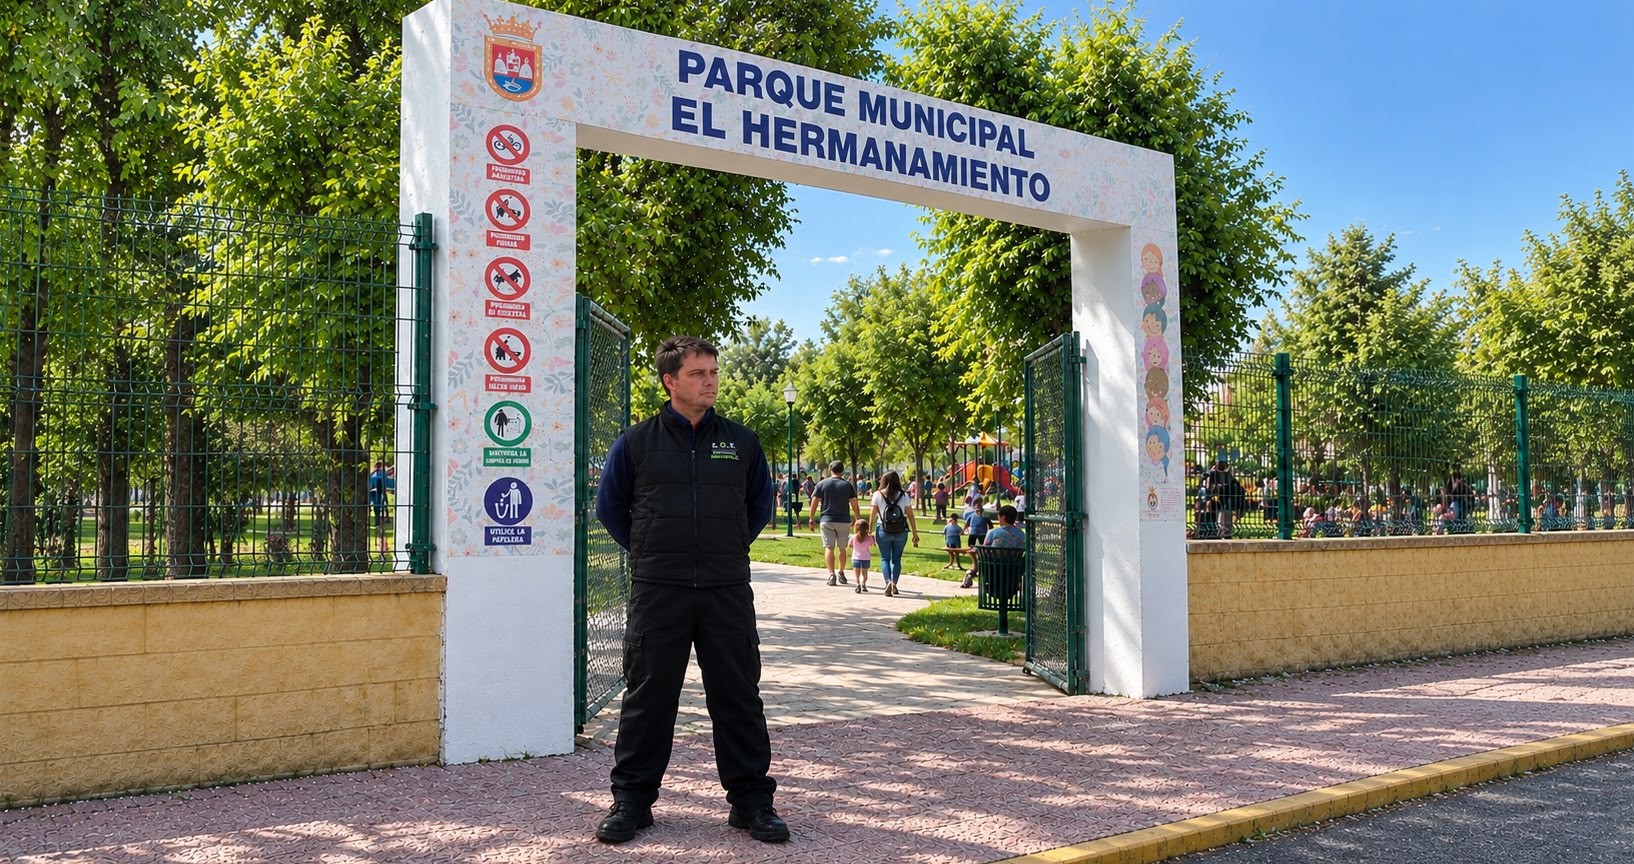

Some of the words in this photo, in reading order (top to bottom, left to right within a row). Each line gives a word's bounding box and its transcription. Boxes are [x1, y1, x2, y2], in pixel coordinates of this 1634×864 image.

[672, 96, 726, 139] EL
[742, 110, 1051, 202] HERMANAMIENTO
[679, 49, 845, 117] PARQUE
[858, 90, 1035, 159] MUNICIPAL
